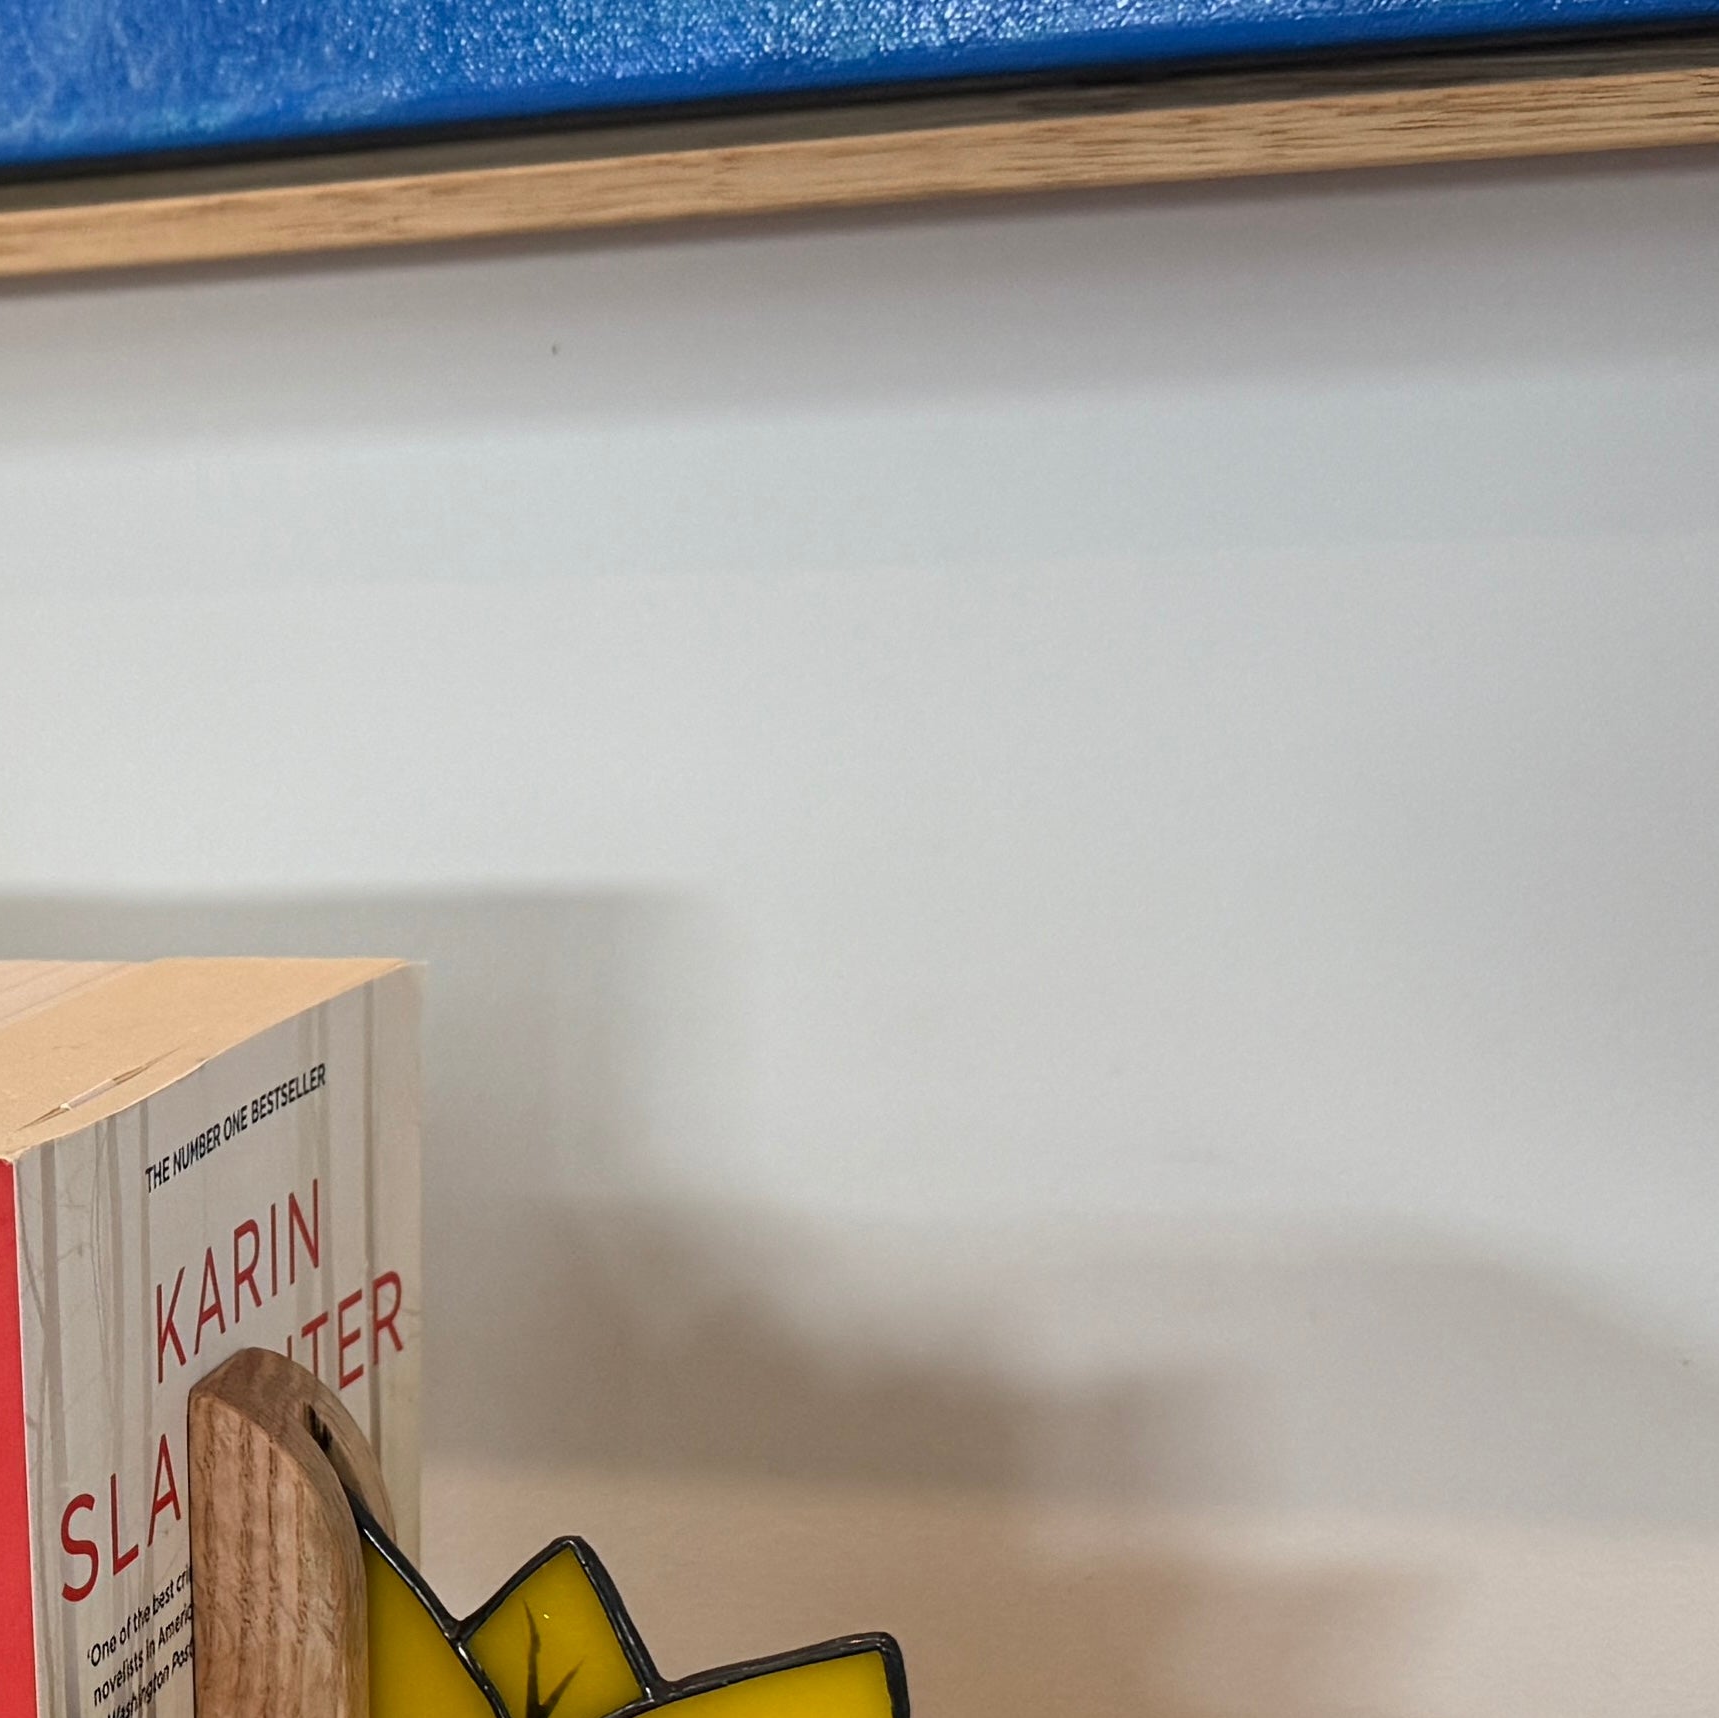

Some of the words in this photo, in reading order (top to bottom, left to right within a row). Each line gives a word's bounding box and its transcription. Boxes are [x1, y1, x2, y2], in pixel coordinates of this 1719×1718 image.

[145, 1156, 170, 1193] THE
[173, 1123, 221, 1175] NUMBER
[223, 1105, 248, 1141] ONE
[251, 1063, 326, 1124] BESTSELLER
[156, 1178, 319, 1384] KARIN
[94, 1649, 143, 1707] novelists
[146, 1638, 155, 1661] in
[158, 1602, 192, 1650] Americ
[119, 1616, 131, 1645] of
[134, 1606, 151, 1633] the
[153, 1578, 174, 1616] best
